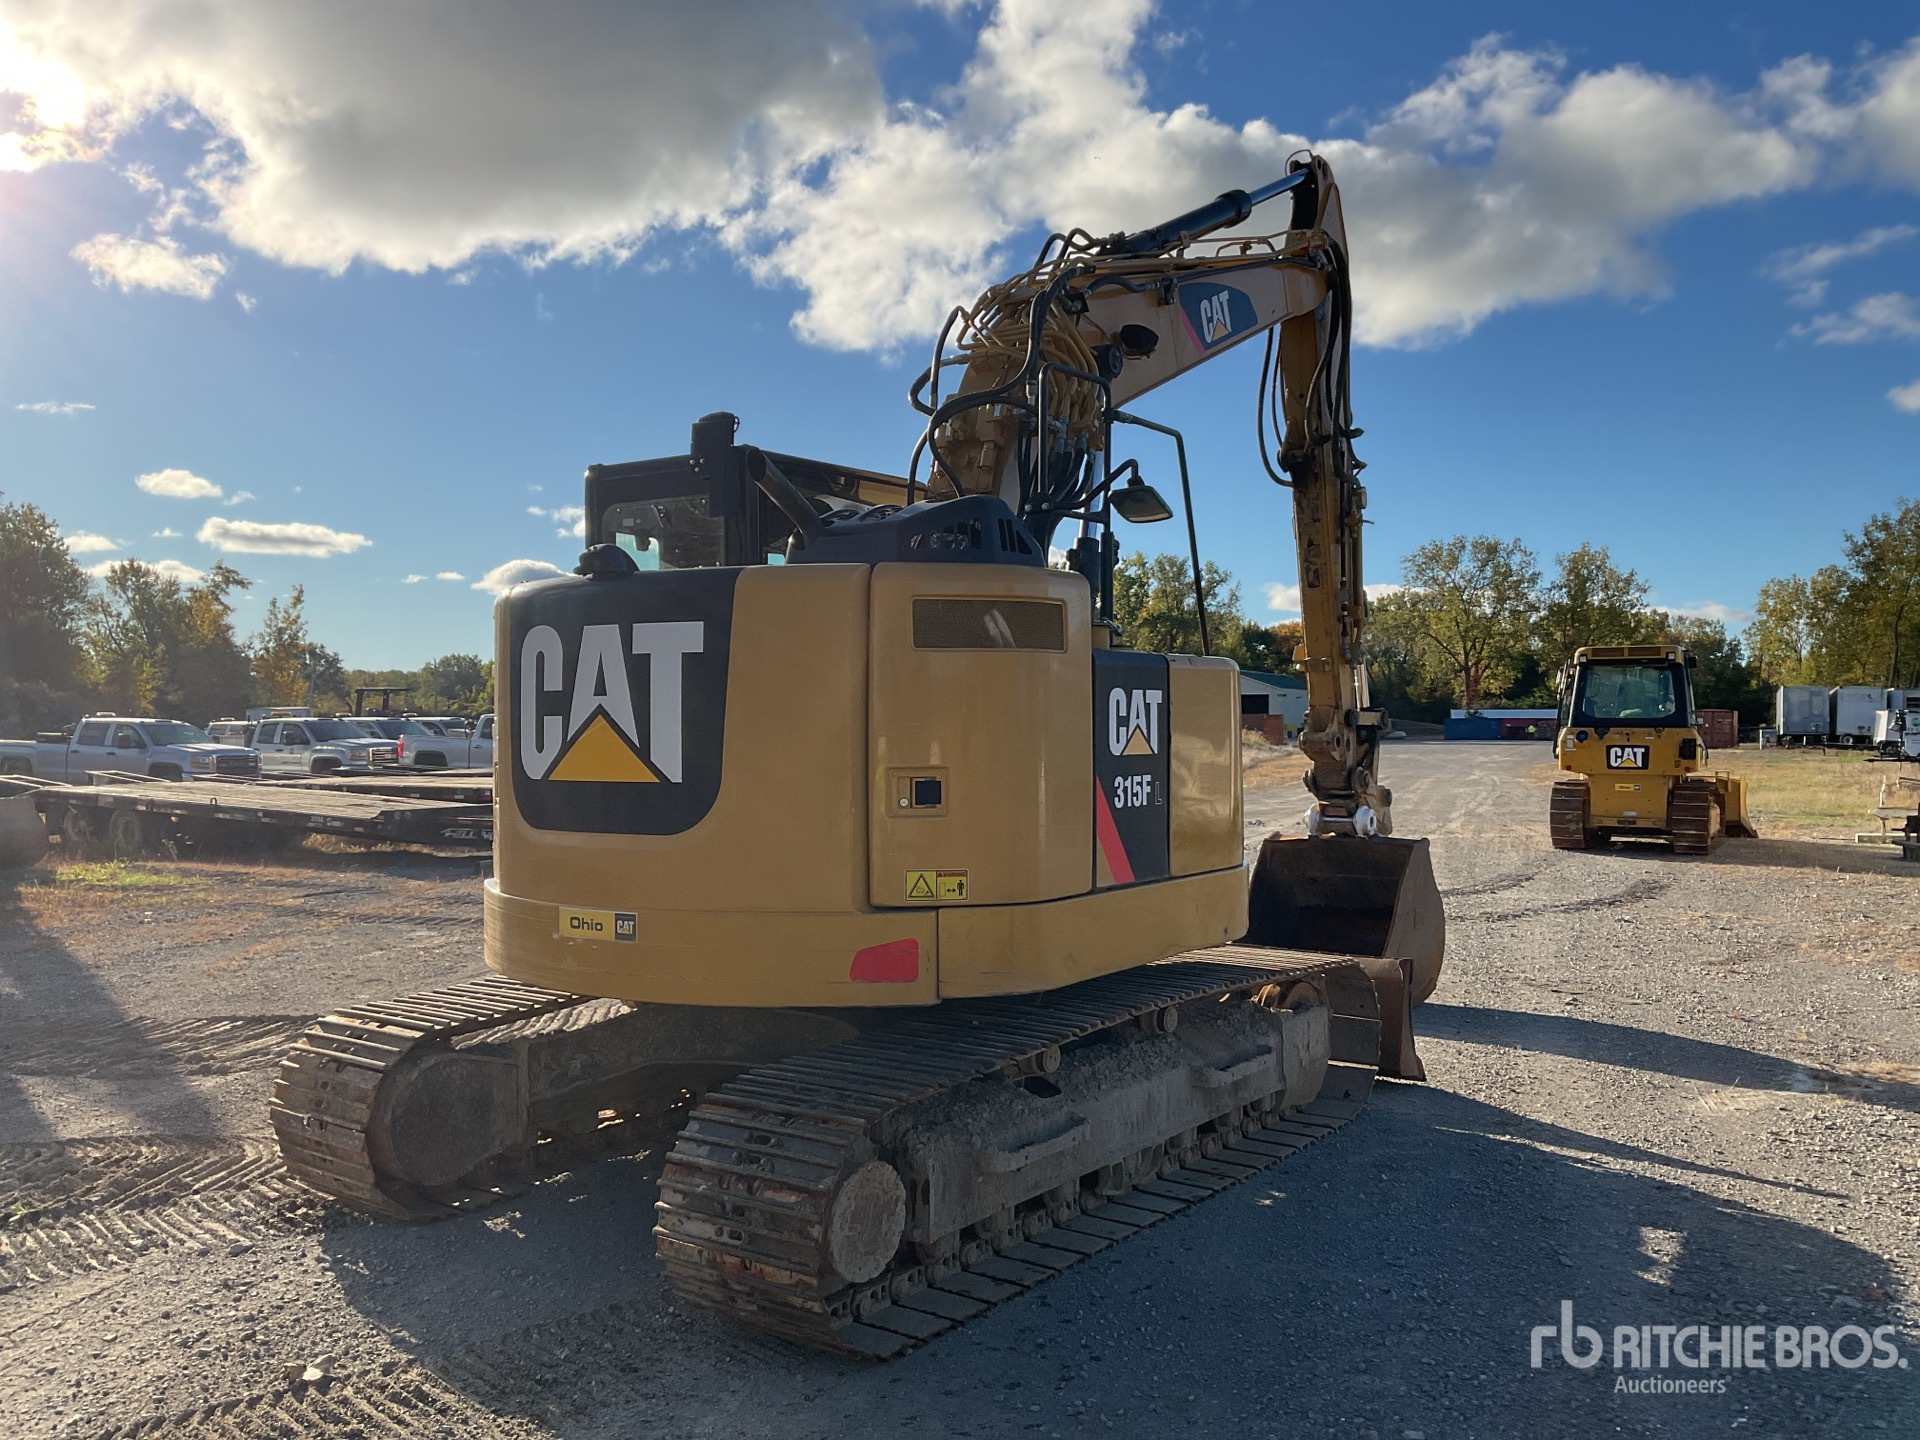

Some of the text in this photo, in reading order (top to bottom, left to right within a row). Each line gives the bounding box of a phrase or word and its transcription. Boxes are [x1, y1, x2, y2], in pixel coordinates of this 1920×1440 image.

[1200, 290, 1231, 343] CAT
[521, 621, 704, 783] CAT
[1109, 687, 1162, 756] CAT
[1610, 747, 1645, 768] CAT
[1114, 775, 1151, 809] 315F
[570, 916, 635, 935] Ohio CAT
